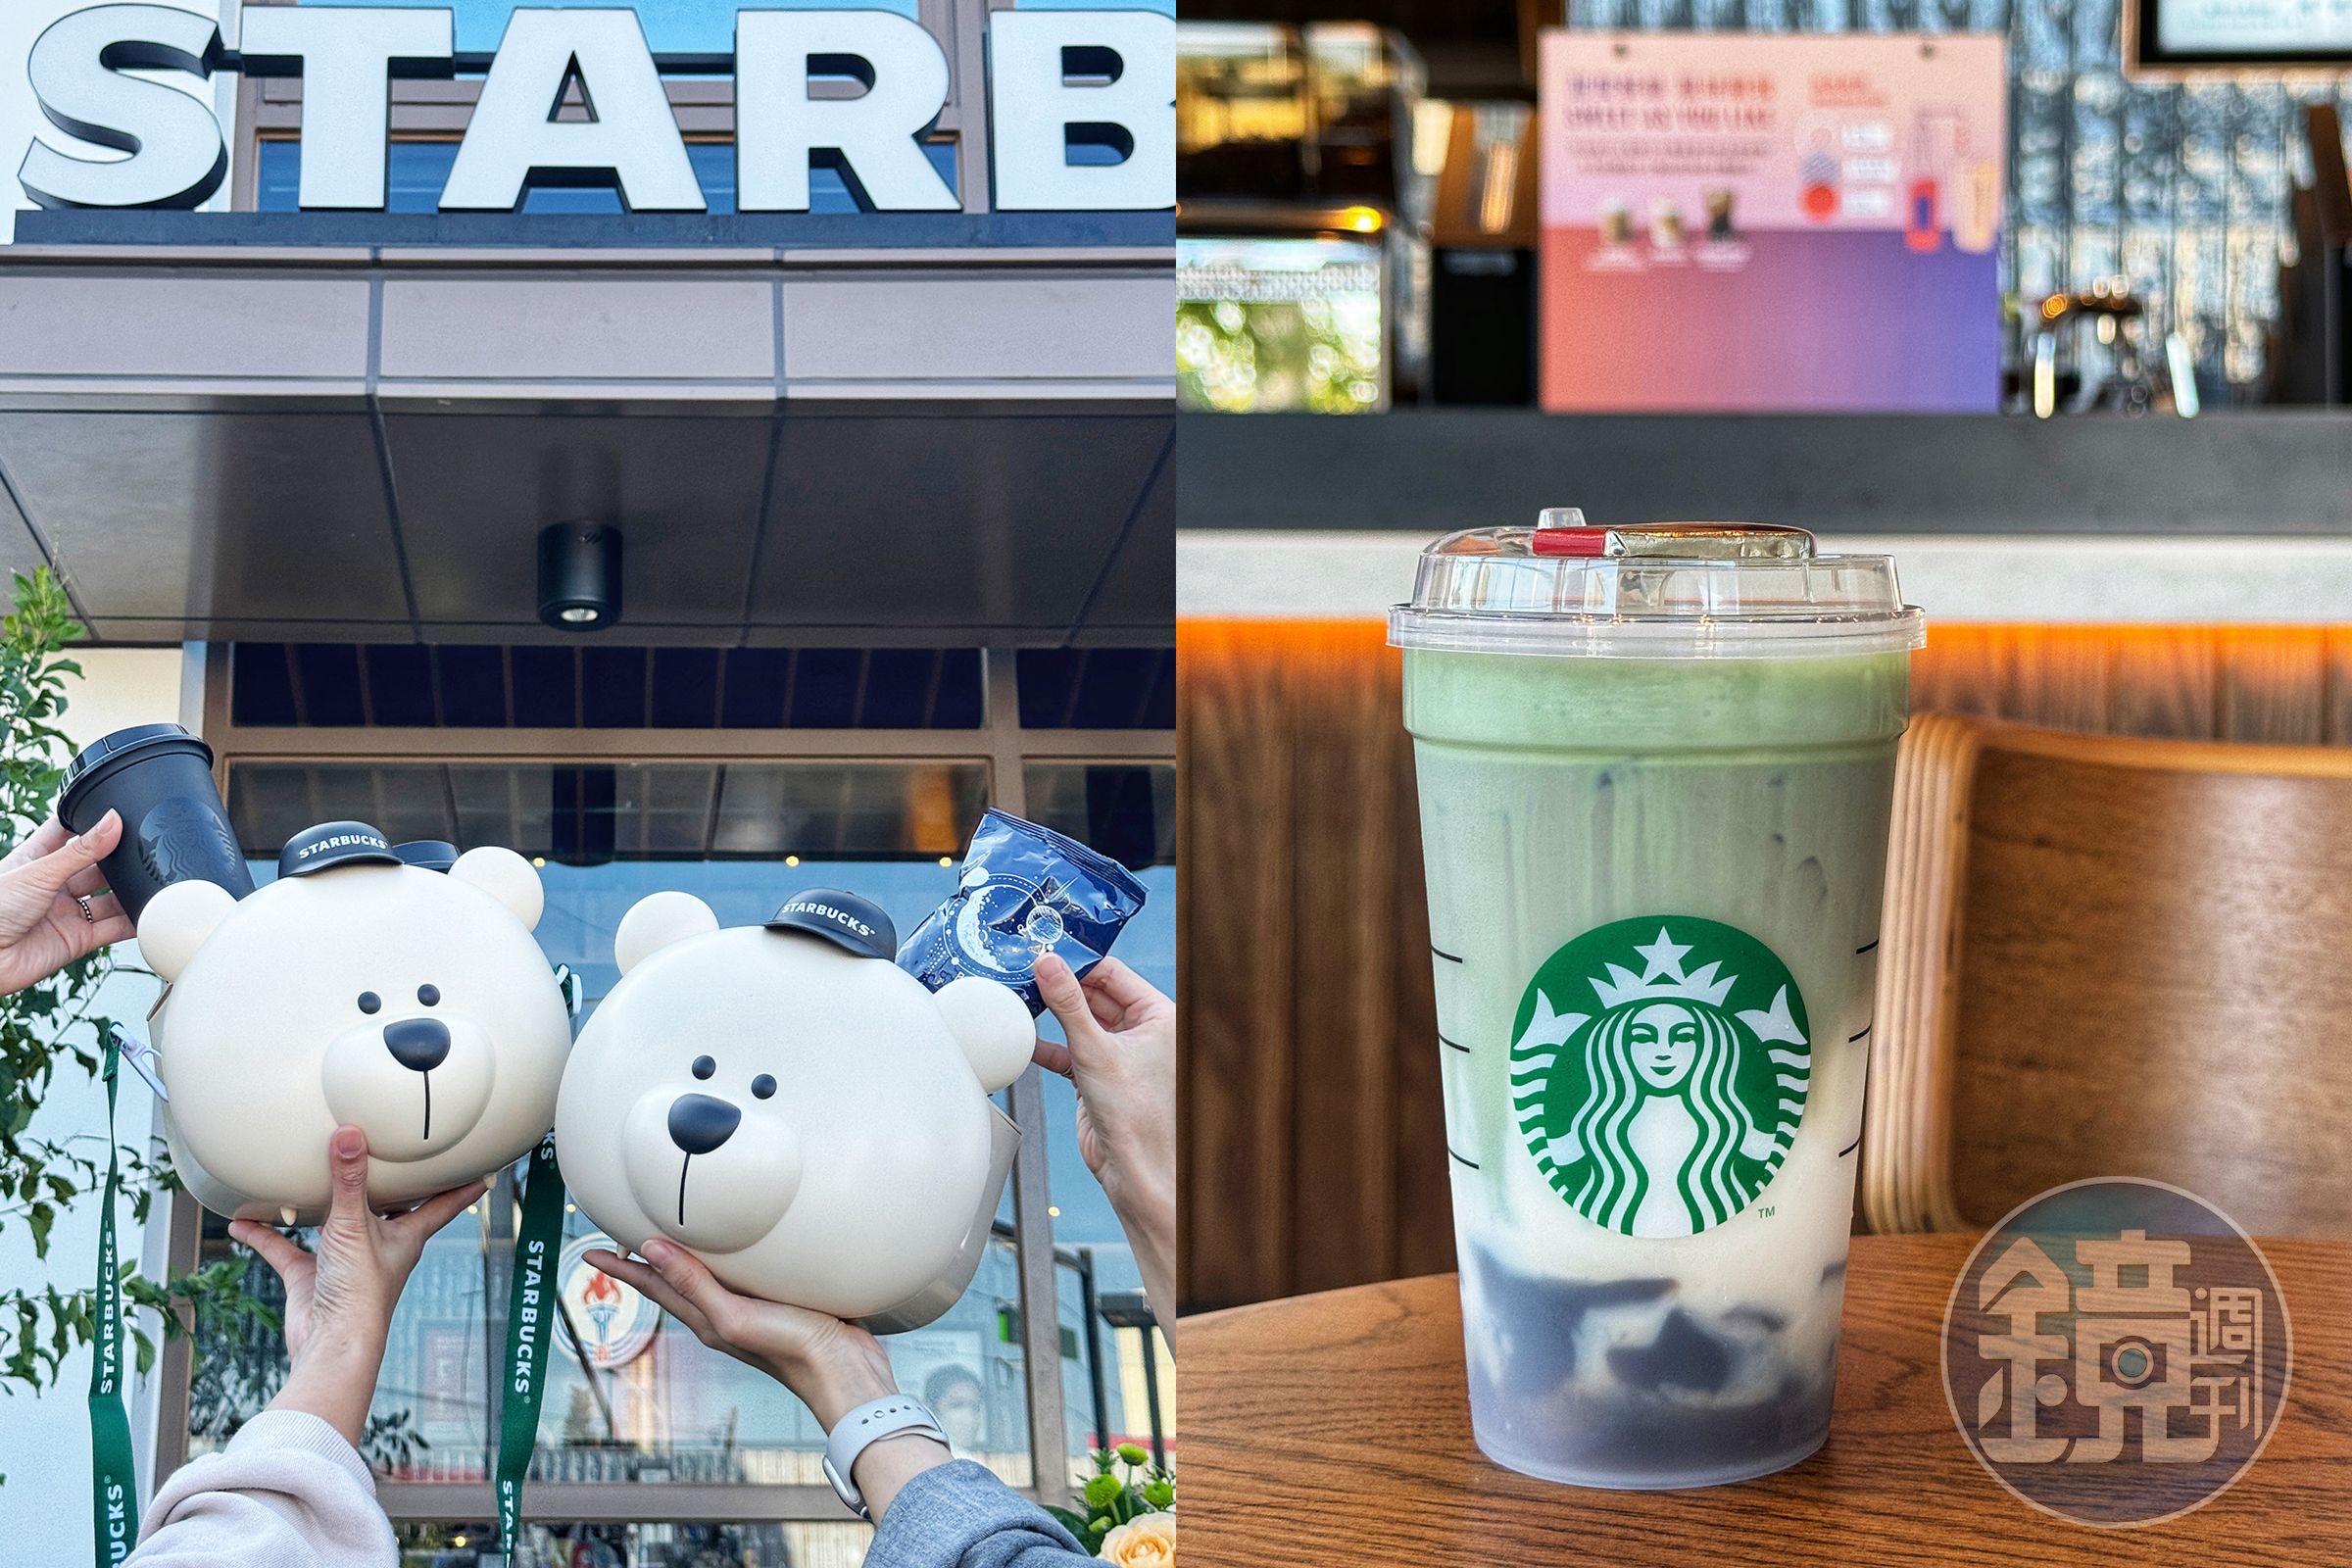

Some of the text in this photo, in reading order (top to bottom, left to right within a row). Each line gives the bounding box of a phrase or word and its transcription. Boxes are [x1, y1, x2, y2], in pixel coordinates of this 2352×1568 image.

[18, 4, 1176, 212] STARB
[1757, 1205, 1775, 1218] TM
[107, 1475, 127, 1568] UCKS
